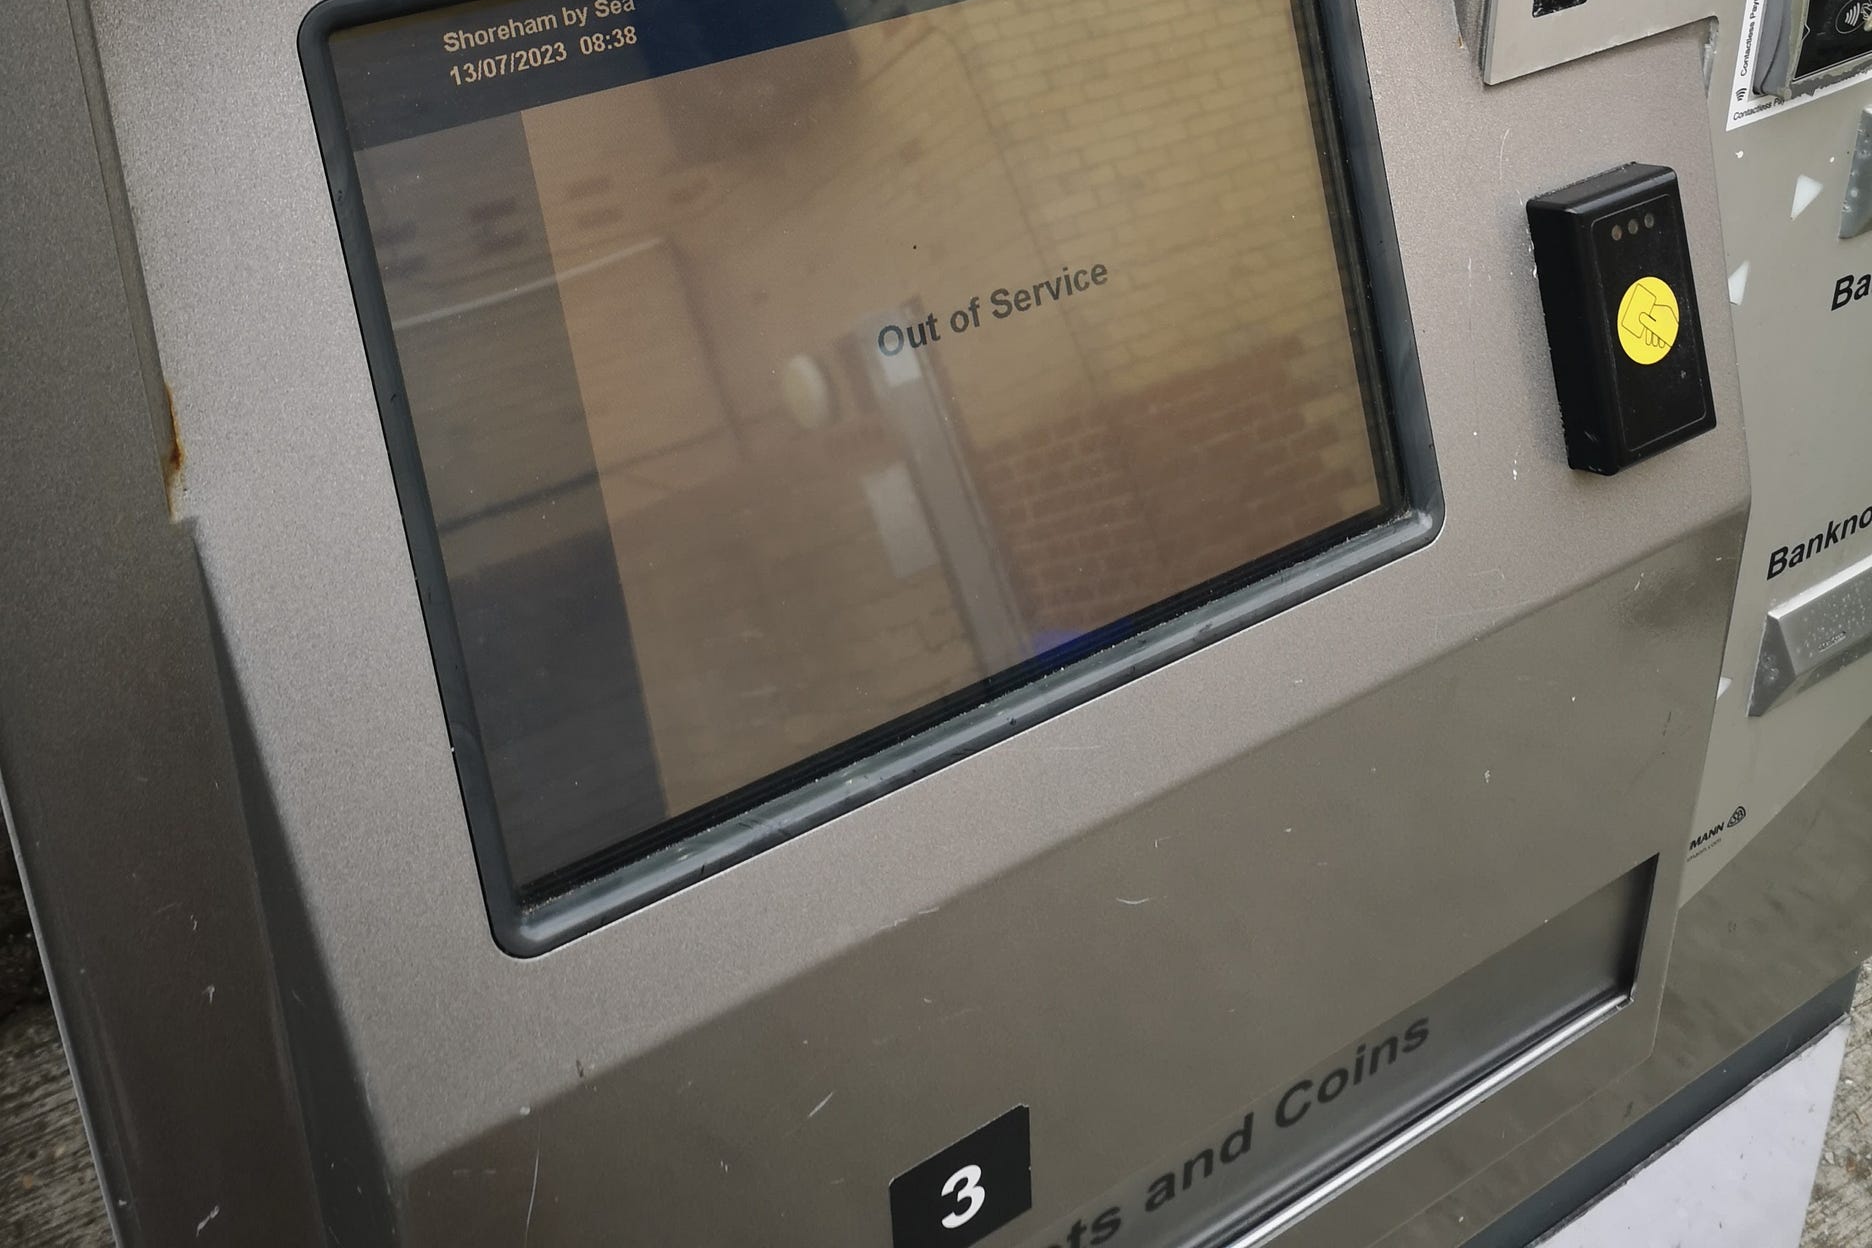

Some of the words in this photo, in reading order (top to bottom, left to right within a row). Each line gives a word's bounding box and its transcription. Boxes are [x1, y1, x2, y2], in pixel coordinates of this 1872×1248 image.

[443, 13, 558, 52] Shoreham
[561, 6, 588, 27] by
[450, 41, 568, 86] 13/07/2023
[579, 25, 638, 55] 08:38
[1740, 20, 1756, 77] Contactless
[877, 313, 941, 357] Out
[950, 296, 981, 333] of
[990, 263, 1108, 319] Service
[1145, 1112, 1254, 1213] and
[1274, 1015, 1431, 1129] Coins
[940, 1163, 986, 1230] 3
